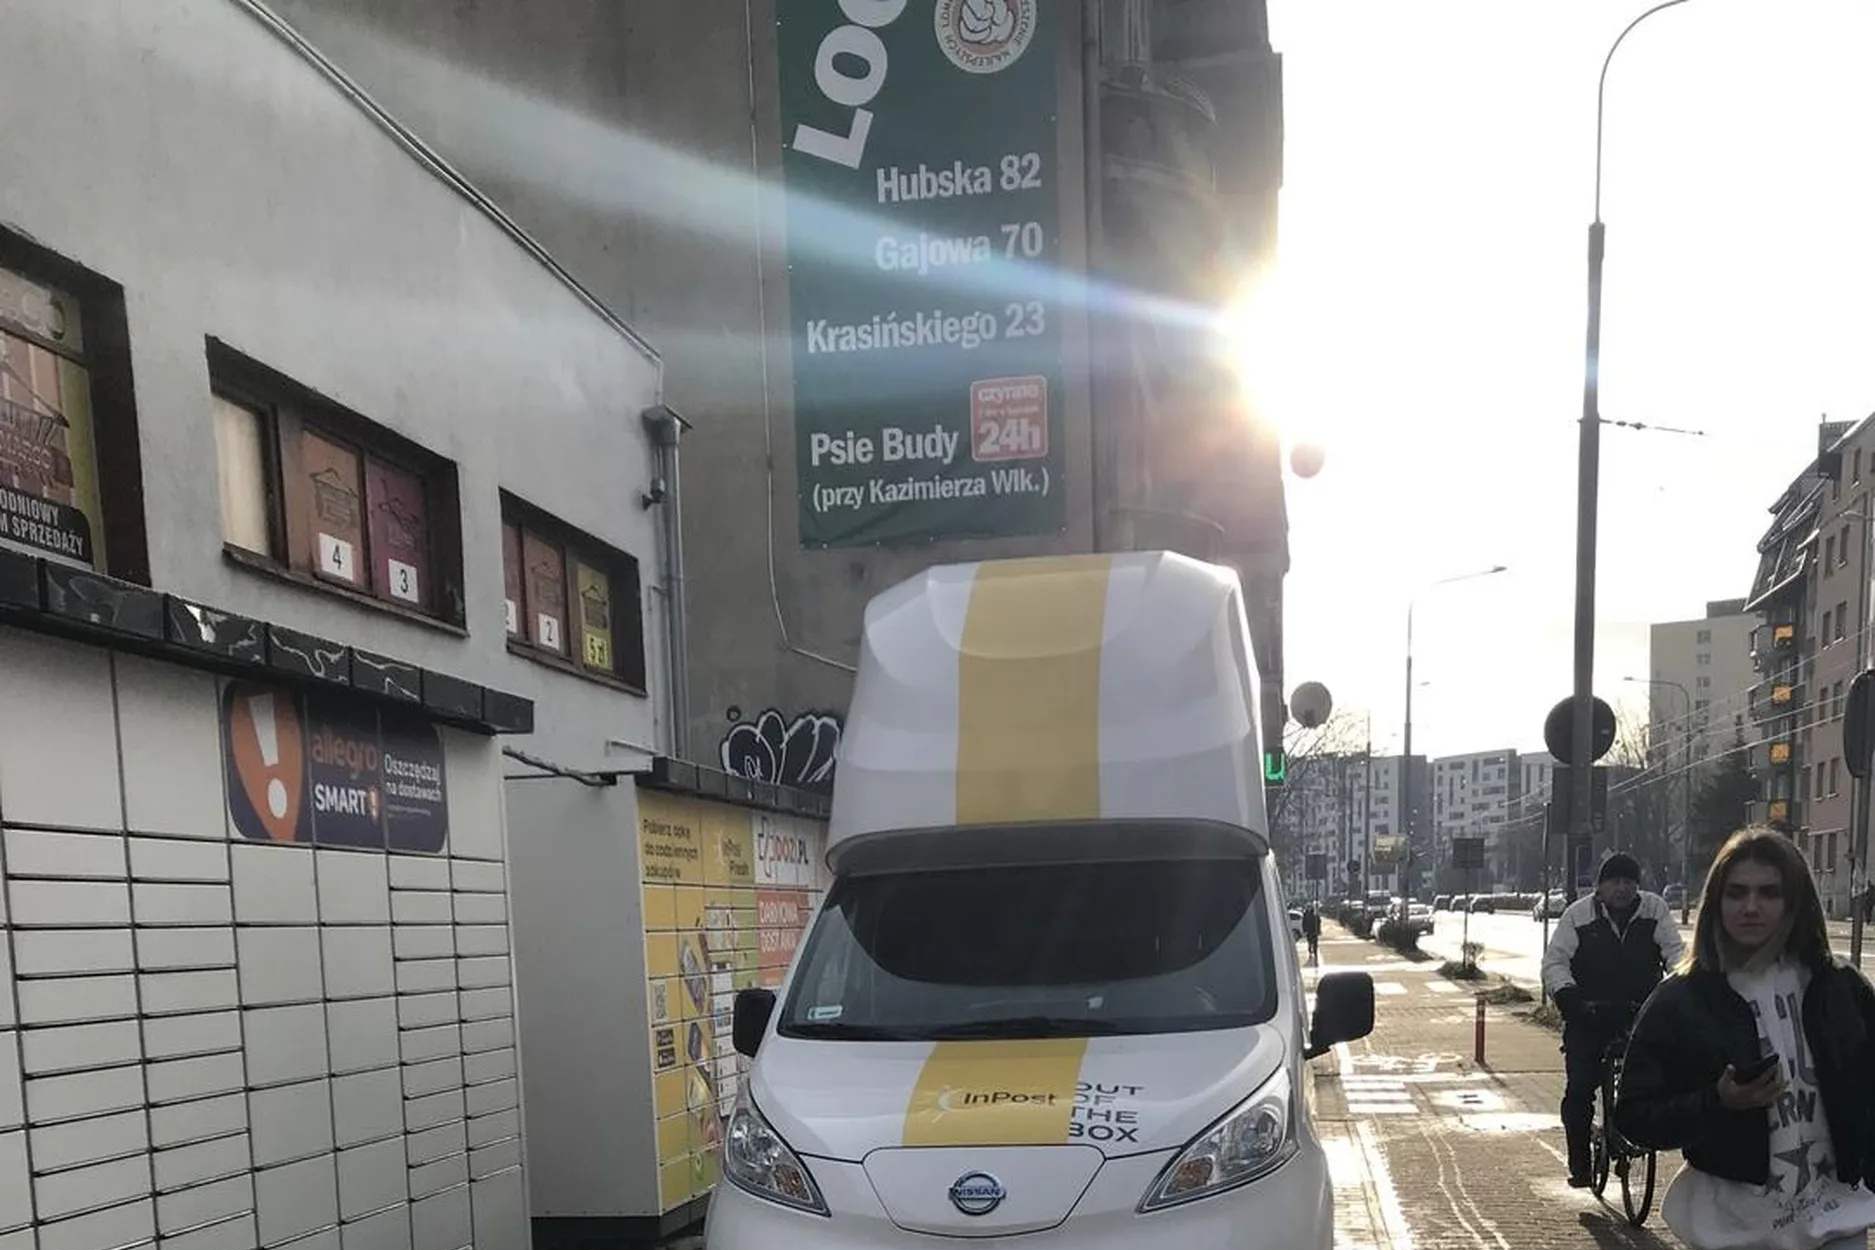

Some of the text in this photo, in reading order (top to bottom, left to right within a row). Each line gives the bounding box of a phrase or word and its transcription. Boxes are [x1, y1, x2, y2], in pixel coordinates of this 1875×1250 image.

[876, 152, 1042, 203] Hubska 82
[875, 221, 1043, 276] Gajowa 70
[806, 300, 1046, 354] Krasińskiego 23
[810, 424, 959, 466] Psie Budy
[979, 417, 1041, 454] 24h
[812, 466, 1050, 512] (przy Kazimierza Wlk.)
[12, 515, 84, 556] SPRZEDAŻY
[332, 544, 342, 570] 4
[400, 568, 409, 594] 3
[963, 1091, 1058, 1106] InPost
[956, 1187, 1001, 1197] NISSAN
